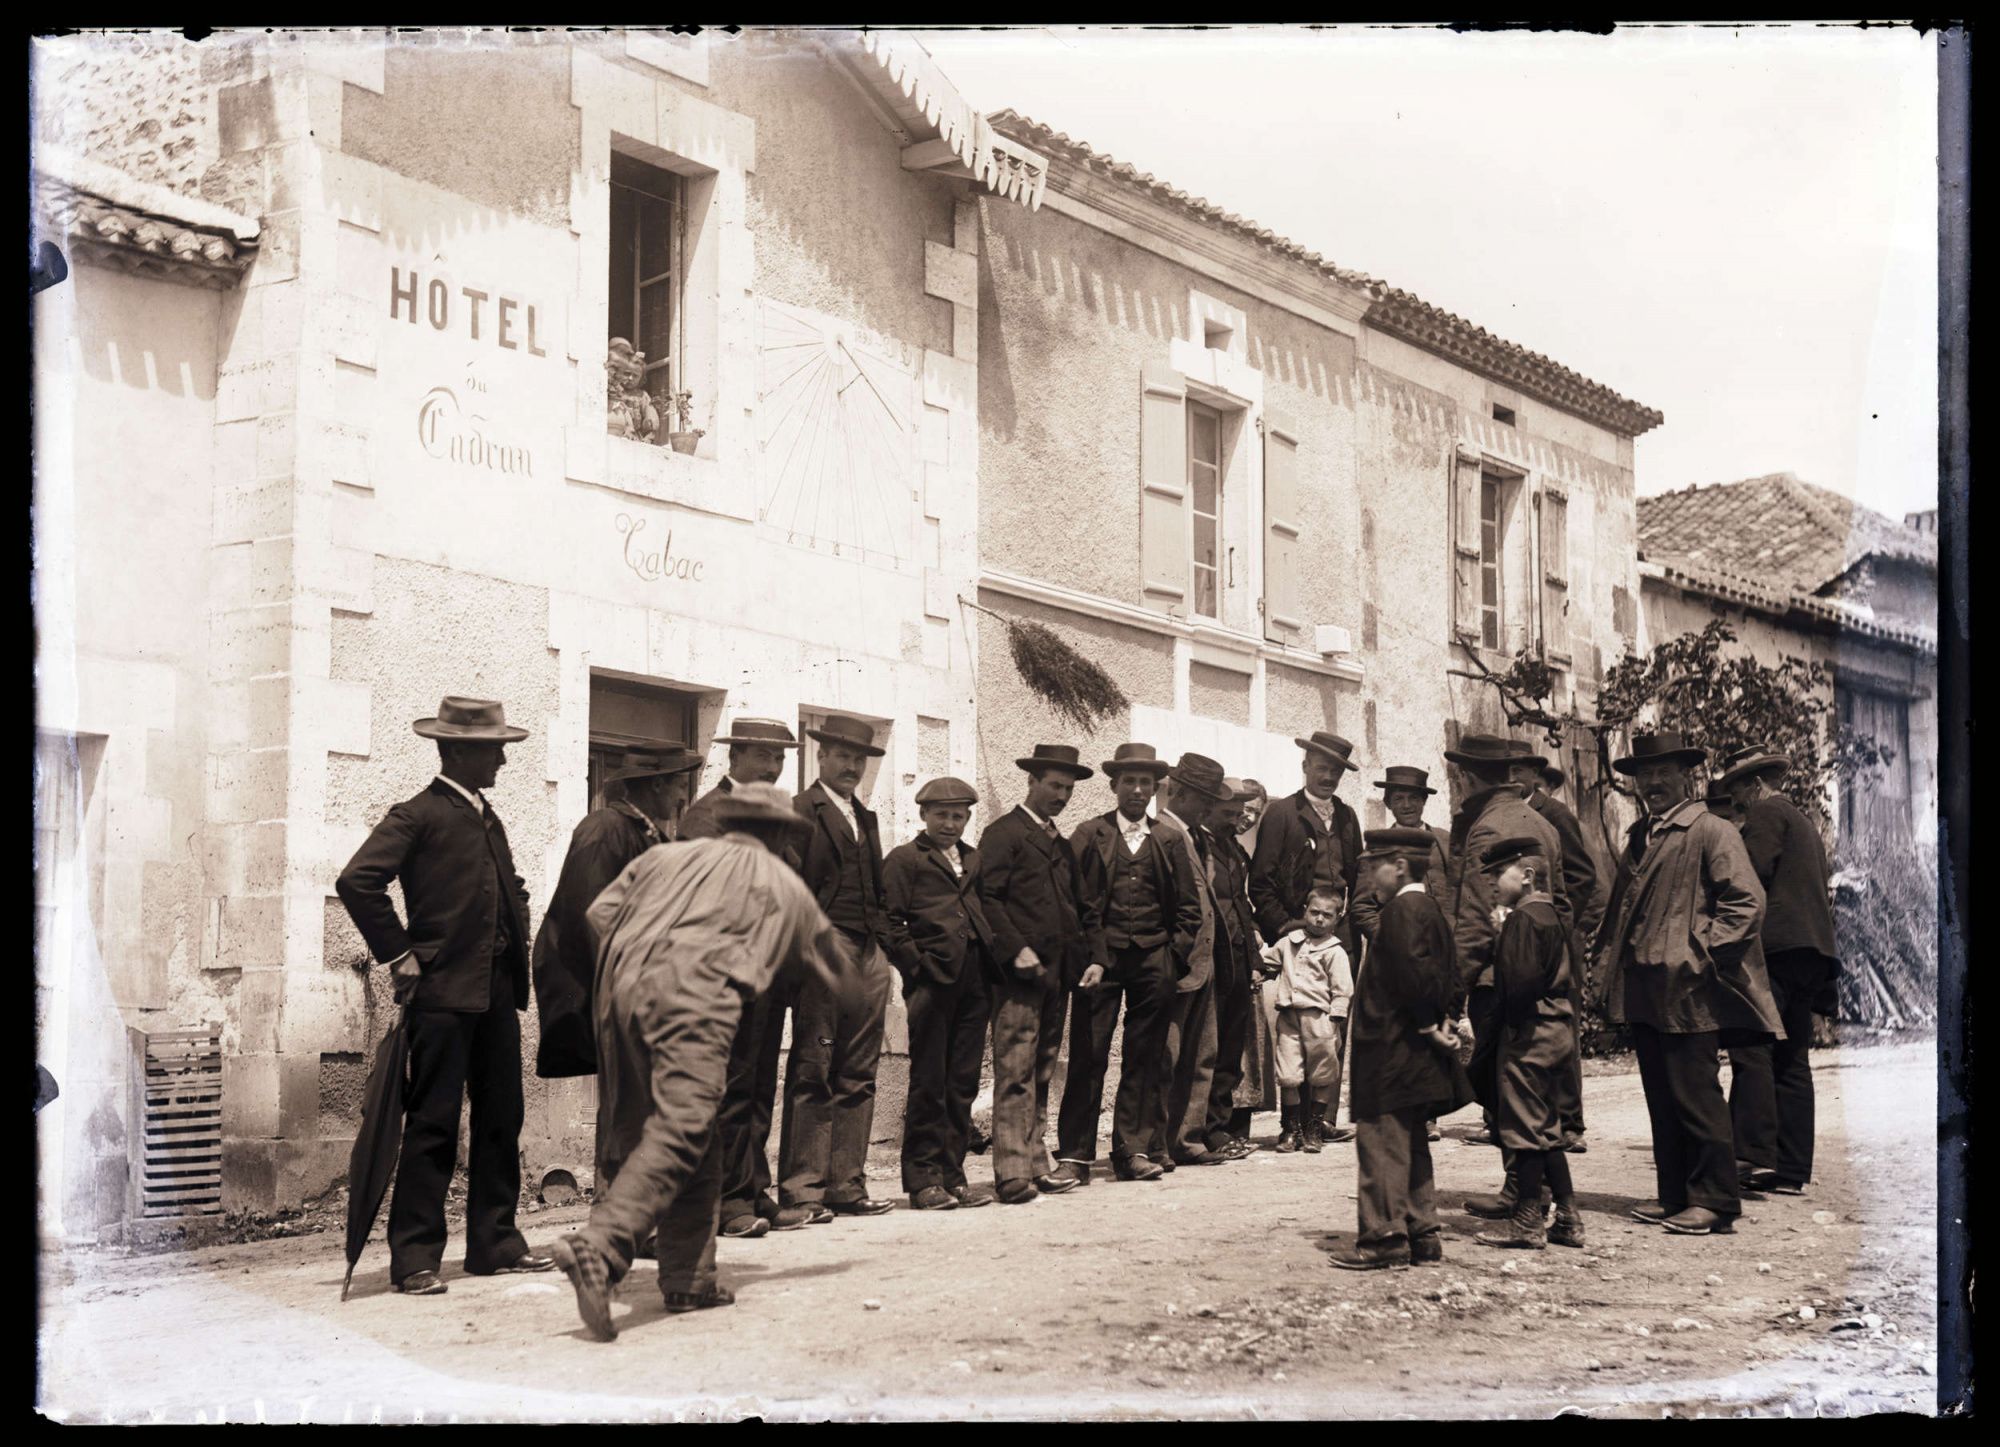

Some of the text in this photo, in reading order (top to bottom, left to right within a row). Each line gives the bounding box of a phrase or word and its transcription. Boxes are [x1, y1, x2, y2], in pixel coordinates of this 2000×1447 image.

[390, 252, 547, 358] HÔTEL
[464, 360, 488, 394] du
[417, 385, 533, 479] Cadran
[615, 512, 704, 582] Tabac
